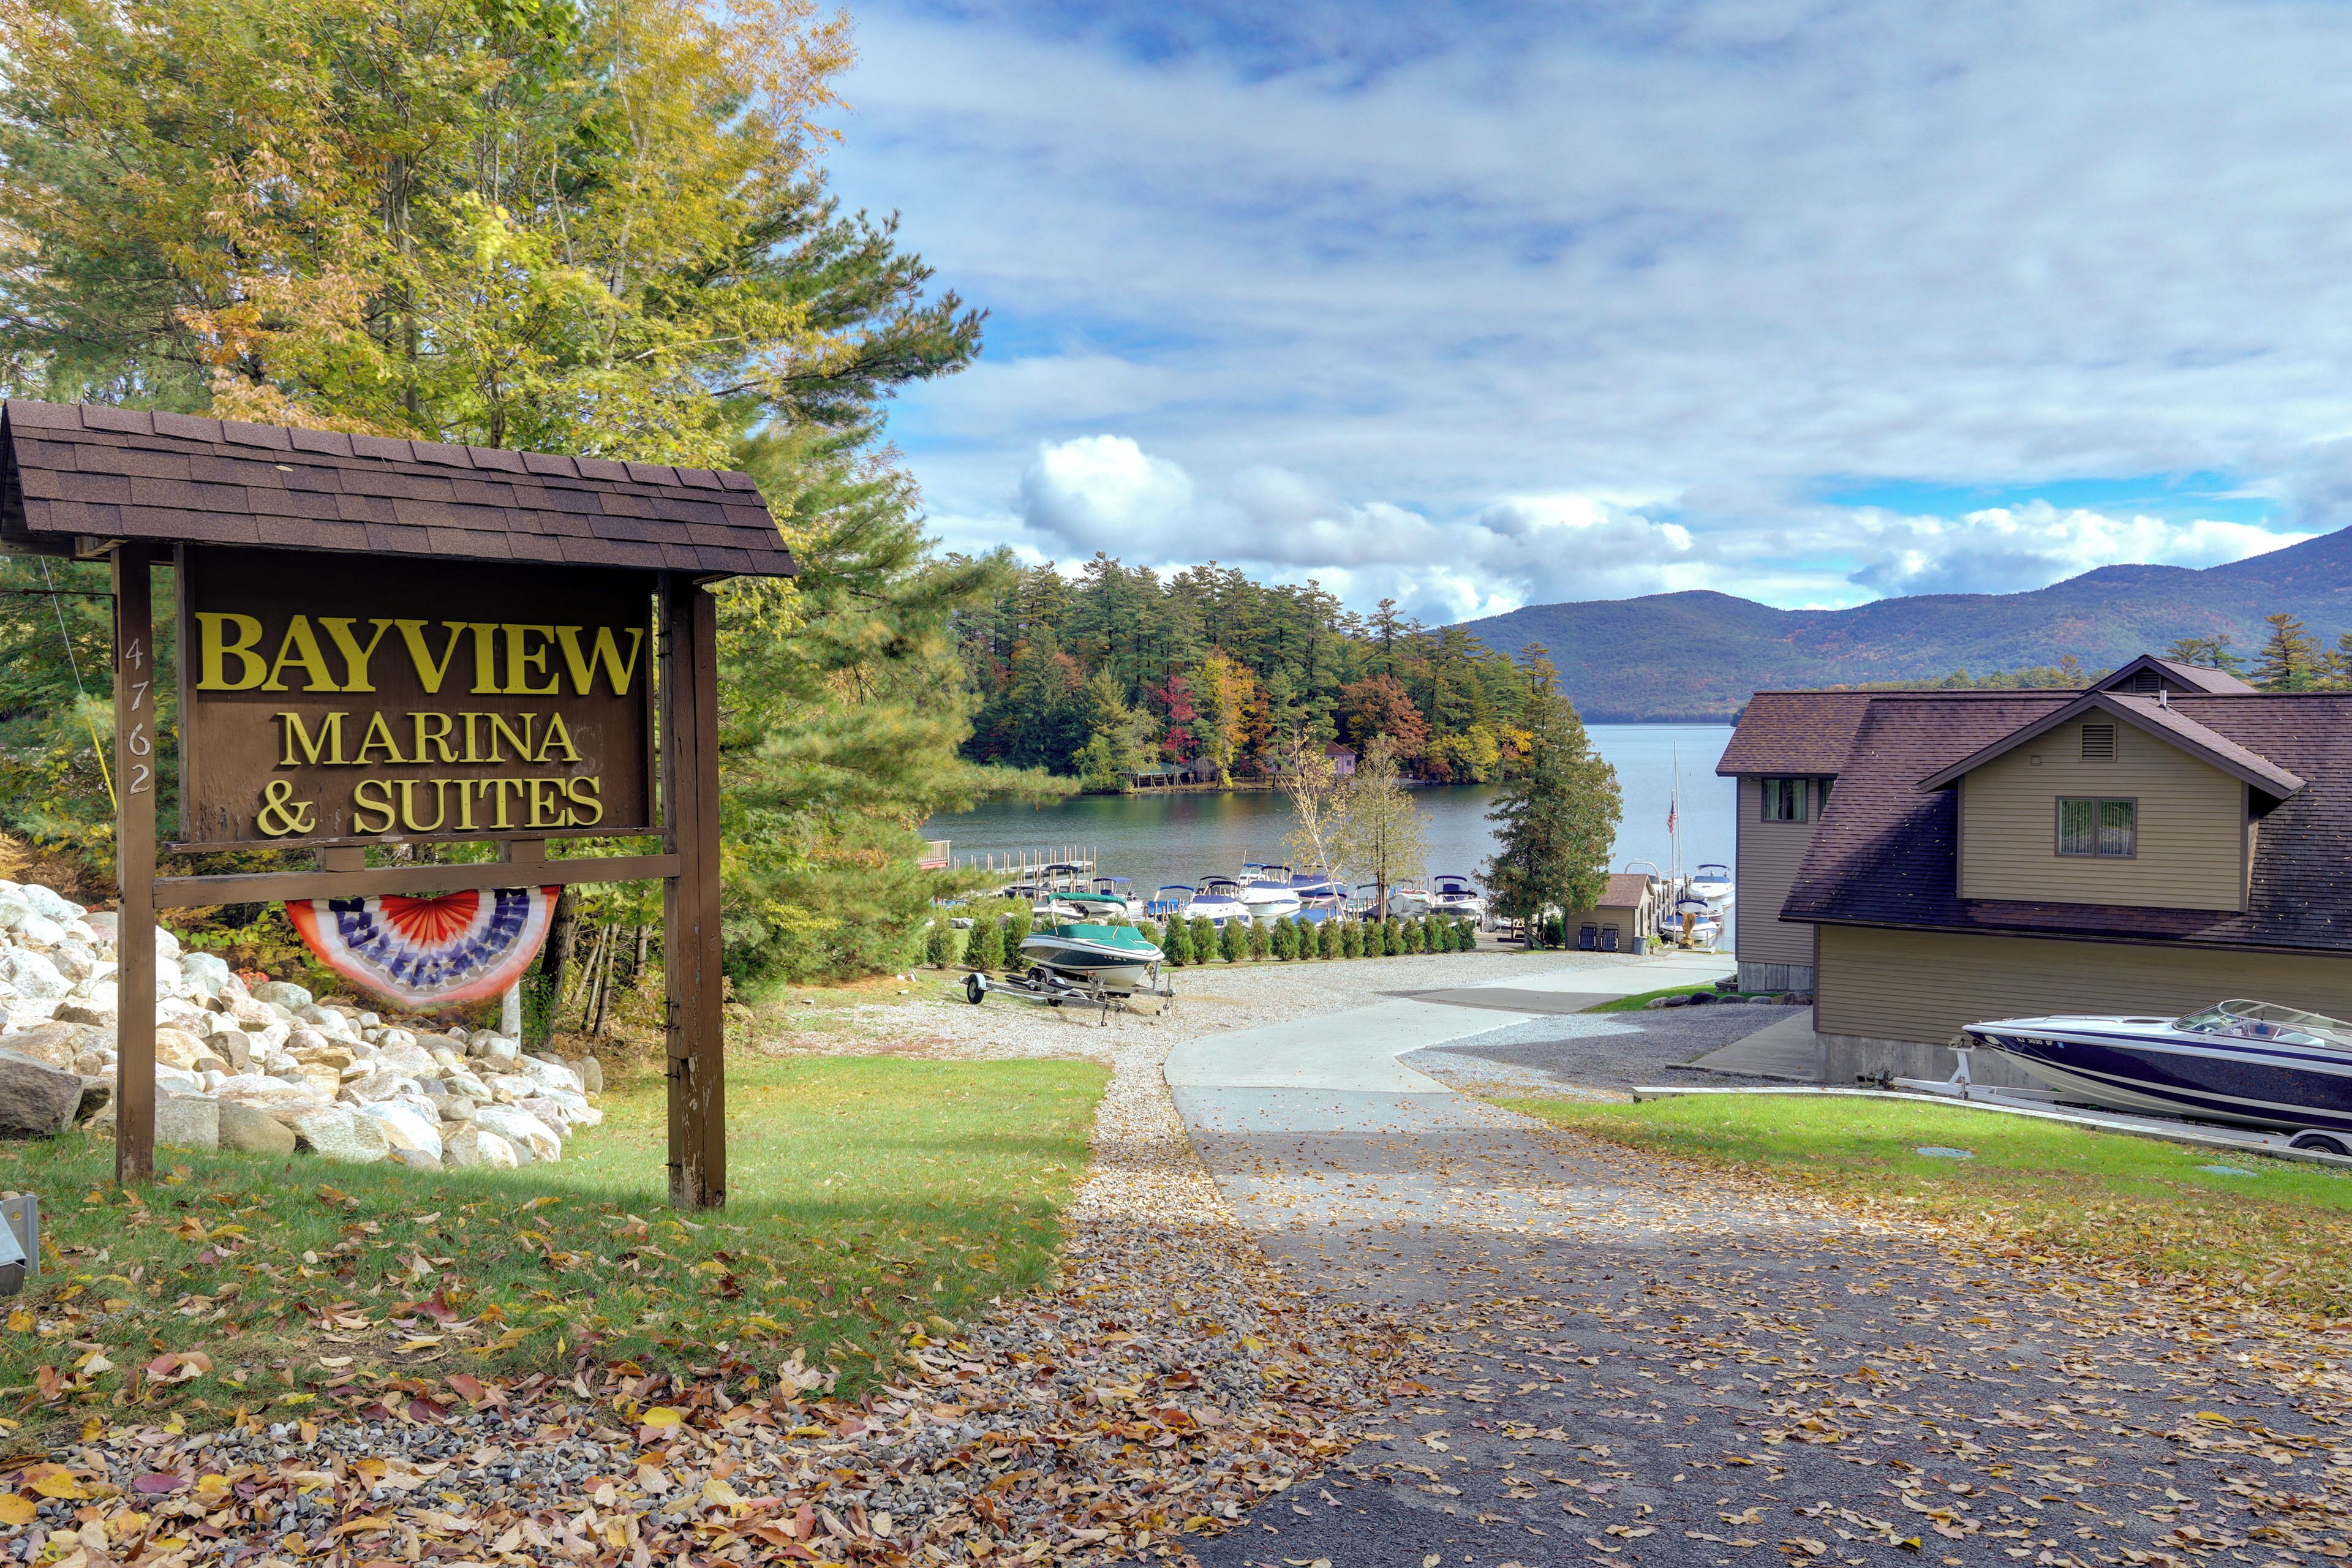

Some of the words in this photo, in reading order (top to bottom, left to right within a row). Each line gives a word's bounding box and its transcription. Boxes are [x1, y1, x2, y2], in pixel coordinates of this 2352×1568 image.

[195, 612, 644, 695] BAYVIEW
[125, 638, 151, 794] 4762
[277, 711, 582, 764] MARINA
[257, 779, 316, 836] &
[353, 776, 603, 833] SUITES
